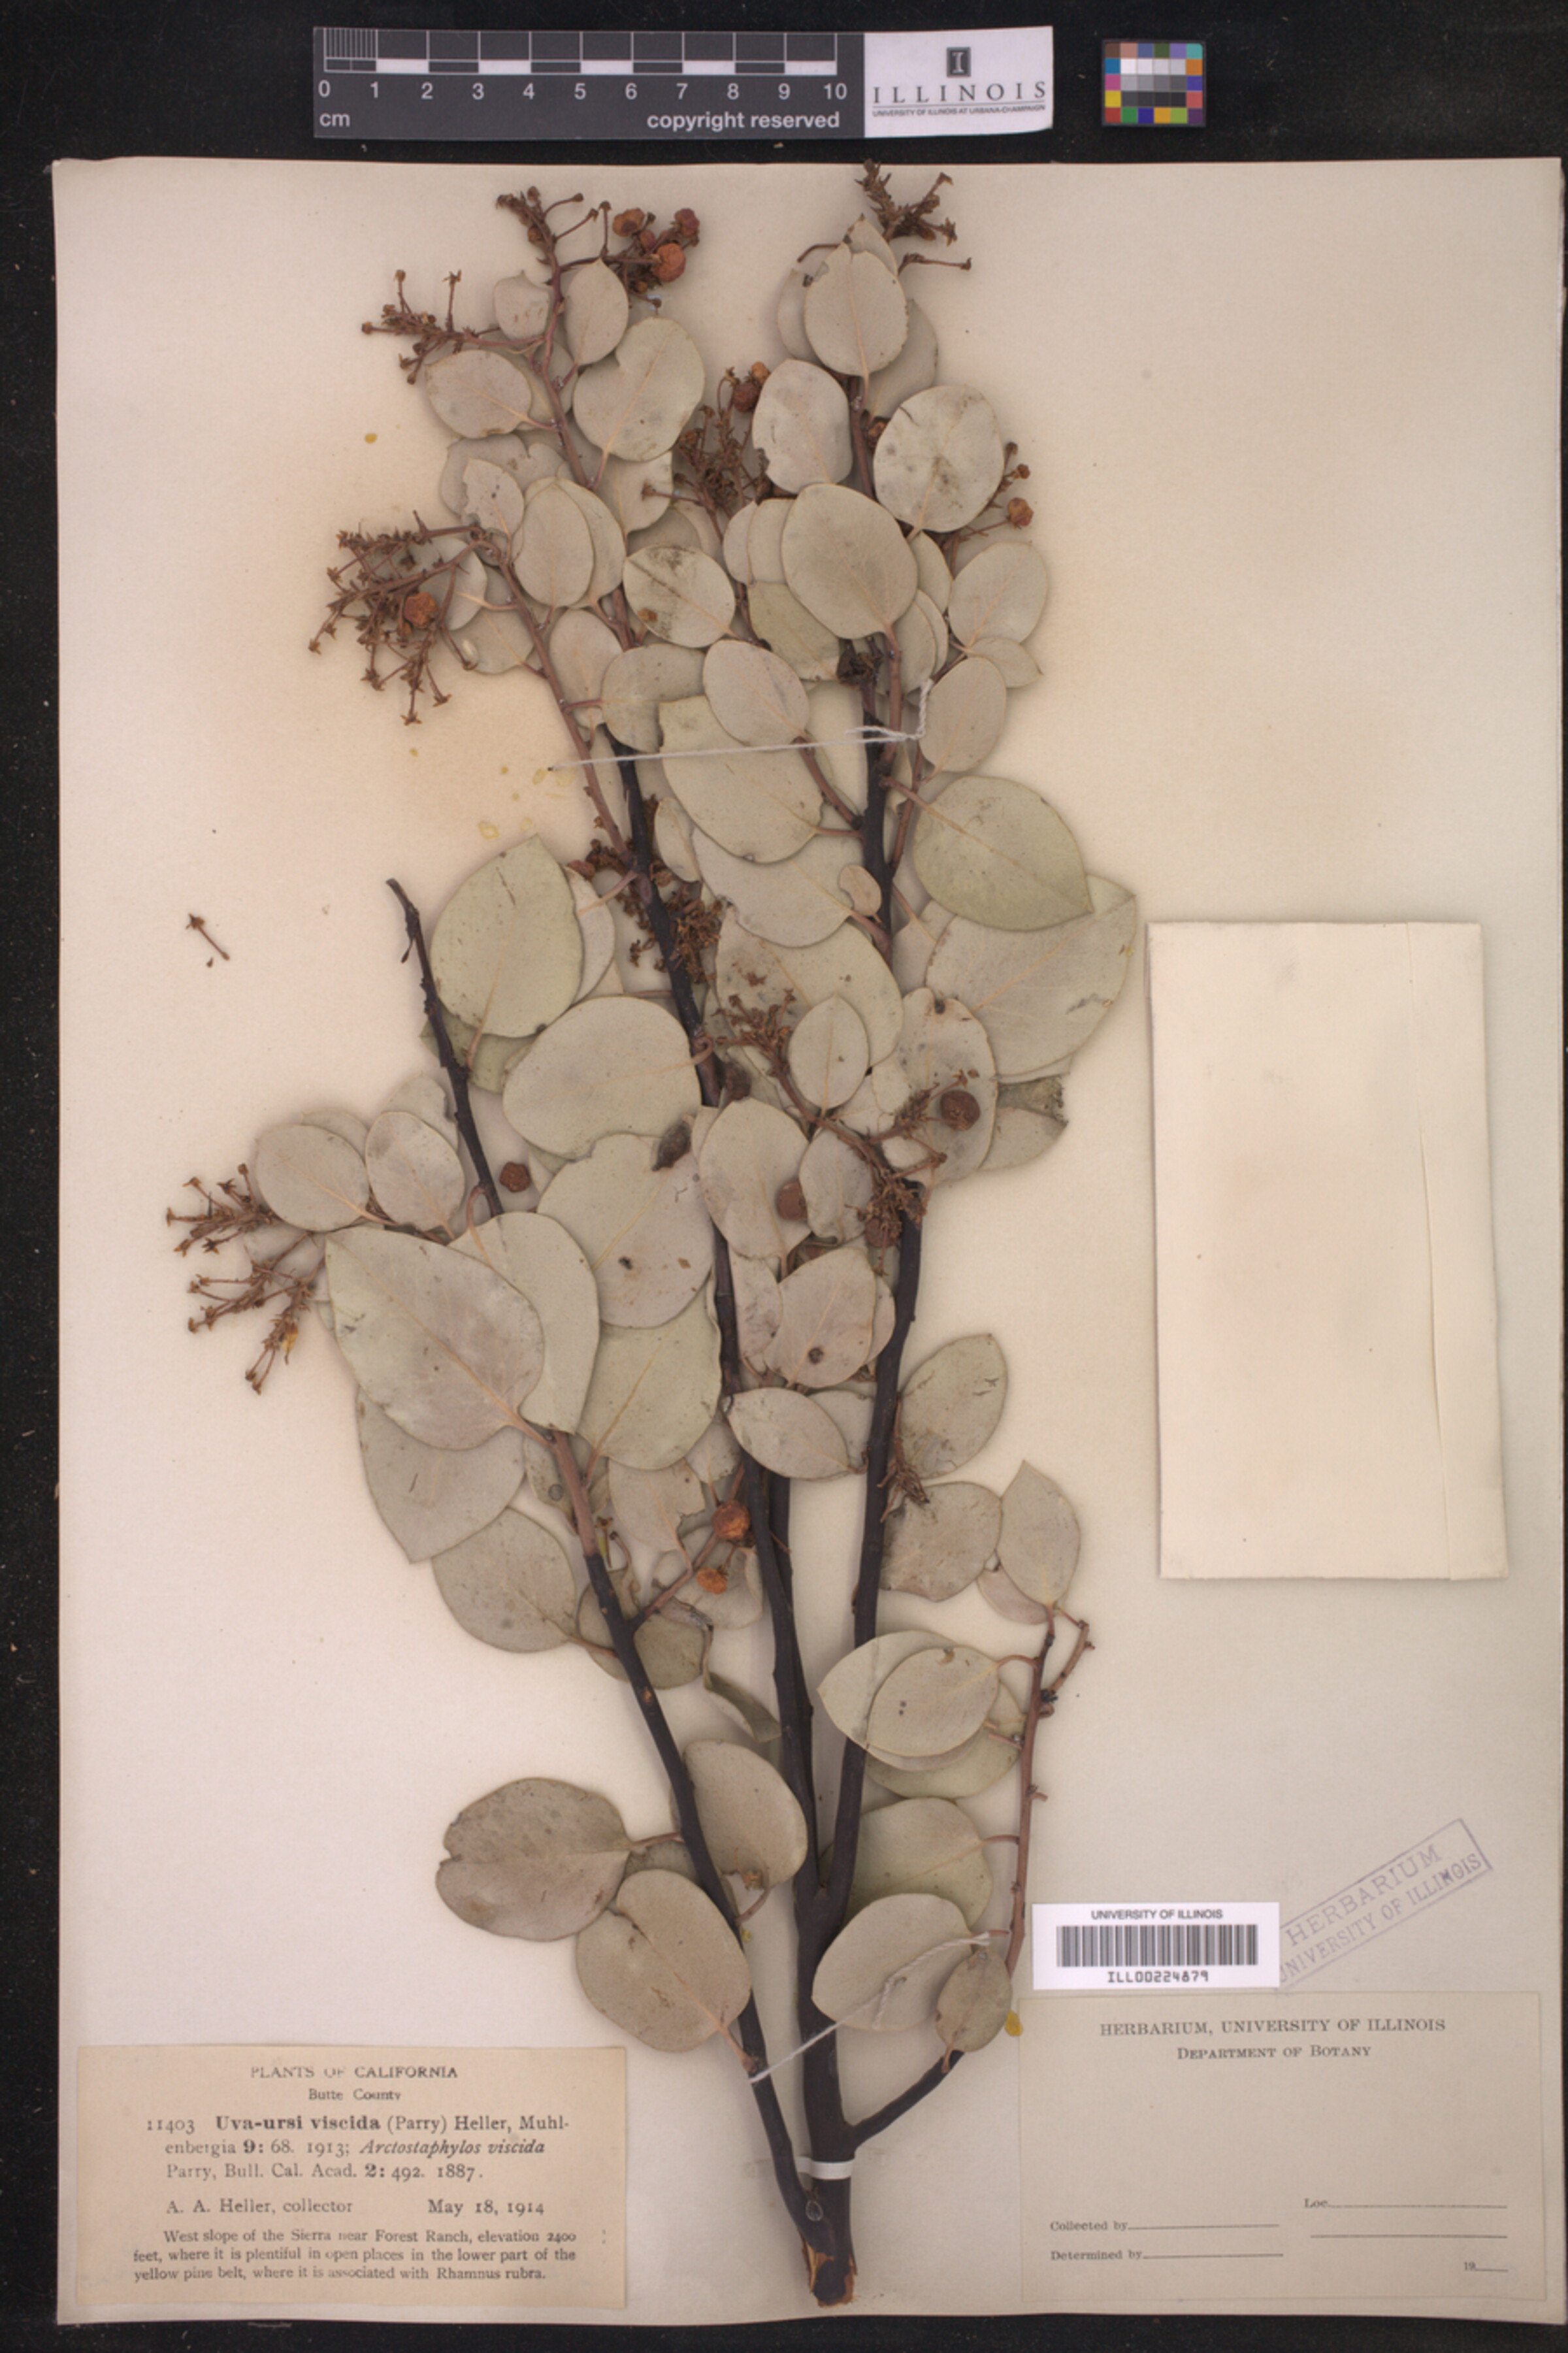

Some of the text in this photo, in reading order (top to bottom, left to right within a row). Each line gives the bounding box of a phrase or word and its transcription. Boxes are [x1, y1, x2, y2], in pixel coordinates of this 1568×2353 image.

[318, 80, 847, 100] 0 1 2 3 4 5 6 7 8 9 10
[873, 81, 1045, 103] ILLINOIS
[319, 110, 350, 127] cm
[647, 111, 840, 132] copyright reserved
[873, 108, 914, 118] UNIVERSITY
[1285, 1844, 1442, 1947] HERBARIUM
[1091, 1909, 1223, 1920] UNIVERSITY OF ILLINOIS
[1381, 1898, 1402, 1920] OF
[1100, 2018, 1445, 2036] HERBARIUM, UNIVERSITY OF ILLINOIS
[354, 2066, 457, 2078] CALIFORNIA
[308, 2088, 400, 2100] Butte County
[216, 2115, 302, 2130] Uva-ursi
[310, 2115, 381, 2130] viscida
[387, 2115, 447, 2134] (Parry)
[454, 2115, 512, 2134] Heller,
[519, 2115, 568, 2130] Muhl-
[243, 2139, 263, 2154] 9:
[270, 2139, 294, 2154] 68.
[308, 2143, 350, 2158] 1913;
[359, 2139, 482, 2159] Arctostaphylos
[488, 2139, 545, 2154] viscida
[167, 2164, 216, 2181] Parry,
[225, 2163, 263, 2177] Bull.
[271, 2163, 302, 2178] Cal.
[312, 2163, 357, 2177] Acad.
[365, 2164, 385, 2178] 2:
[167, 2198, 353, 2214] A. A. Heller, collector
[428, 2199, 544, 2217] May 18, 1914
[1050, 2220, 1128, 2232] Collected by
[163, 2229, 576, 2245] West slope of the Sierra near Forest Ranch, elevation 2400
[133, 2246, 576, 2263] feet, where it is plentiful in open places in the lower part of the
[1051, 2249, 1142, 2262] Determined by
[135, 2267, 179, 2283] yellow
[184, 2266, 212, 2282] pine
[218, 2266, 246, 2280] belt,
[252, 2265, 294, 2279] where
[299, 2265, 308, 2278] it
[313, 2265, 324, 2278] is
[400, 2267, 429, 2279] with
[437, 2267, 501, 2280] Rhamnus
[506, 2267, 546, 2279] rubra.
